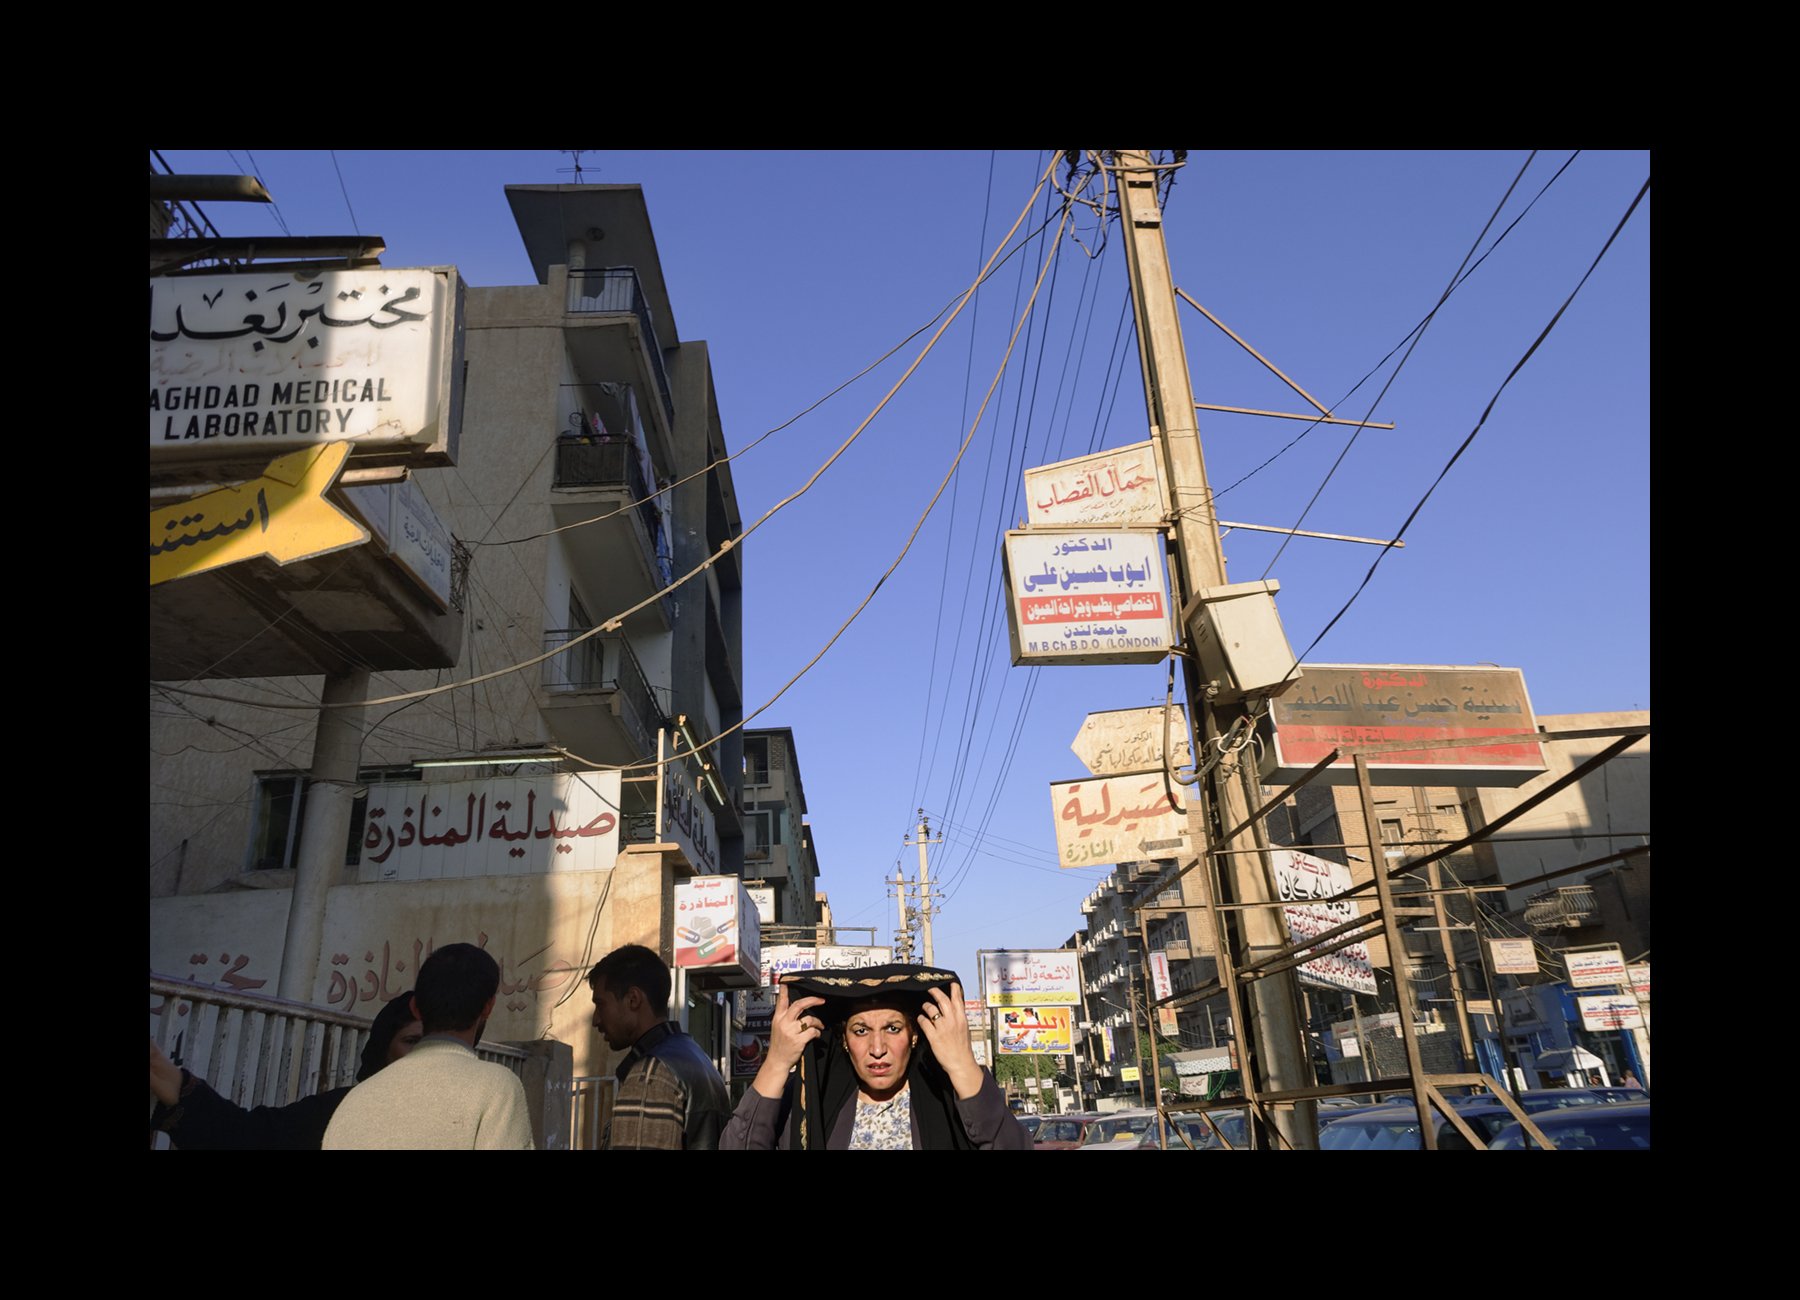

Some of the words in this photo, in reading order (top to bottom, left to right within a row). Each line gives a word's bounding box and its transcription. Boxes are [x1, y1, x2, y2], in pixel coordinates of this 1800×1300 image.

[271, 377, 392, 406] MEDICAL
[164, 407, 355, 440] LABORATORY
[1053, 537, 1112, 556] الدكتور
[1023, 561, 1058, 592] علي
[1060, 561, 1109, 591] حسين
[1110, 556, 1151, 590] ايوب
[1026, 599, 1058, 621] العيون
[1114, 595, 1158, 619] اختصاصي
[1063, 625, 1092, 639] لندن
[1092, 624, 1128, 638] جامعة
[1106, 636, 1163, 649] (LONDON)
[488, 788, 617, 860] صيدلية
[1062, 781, 1180, 839] صيدلية
[364, 791, 487, 864] المناذرة
